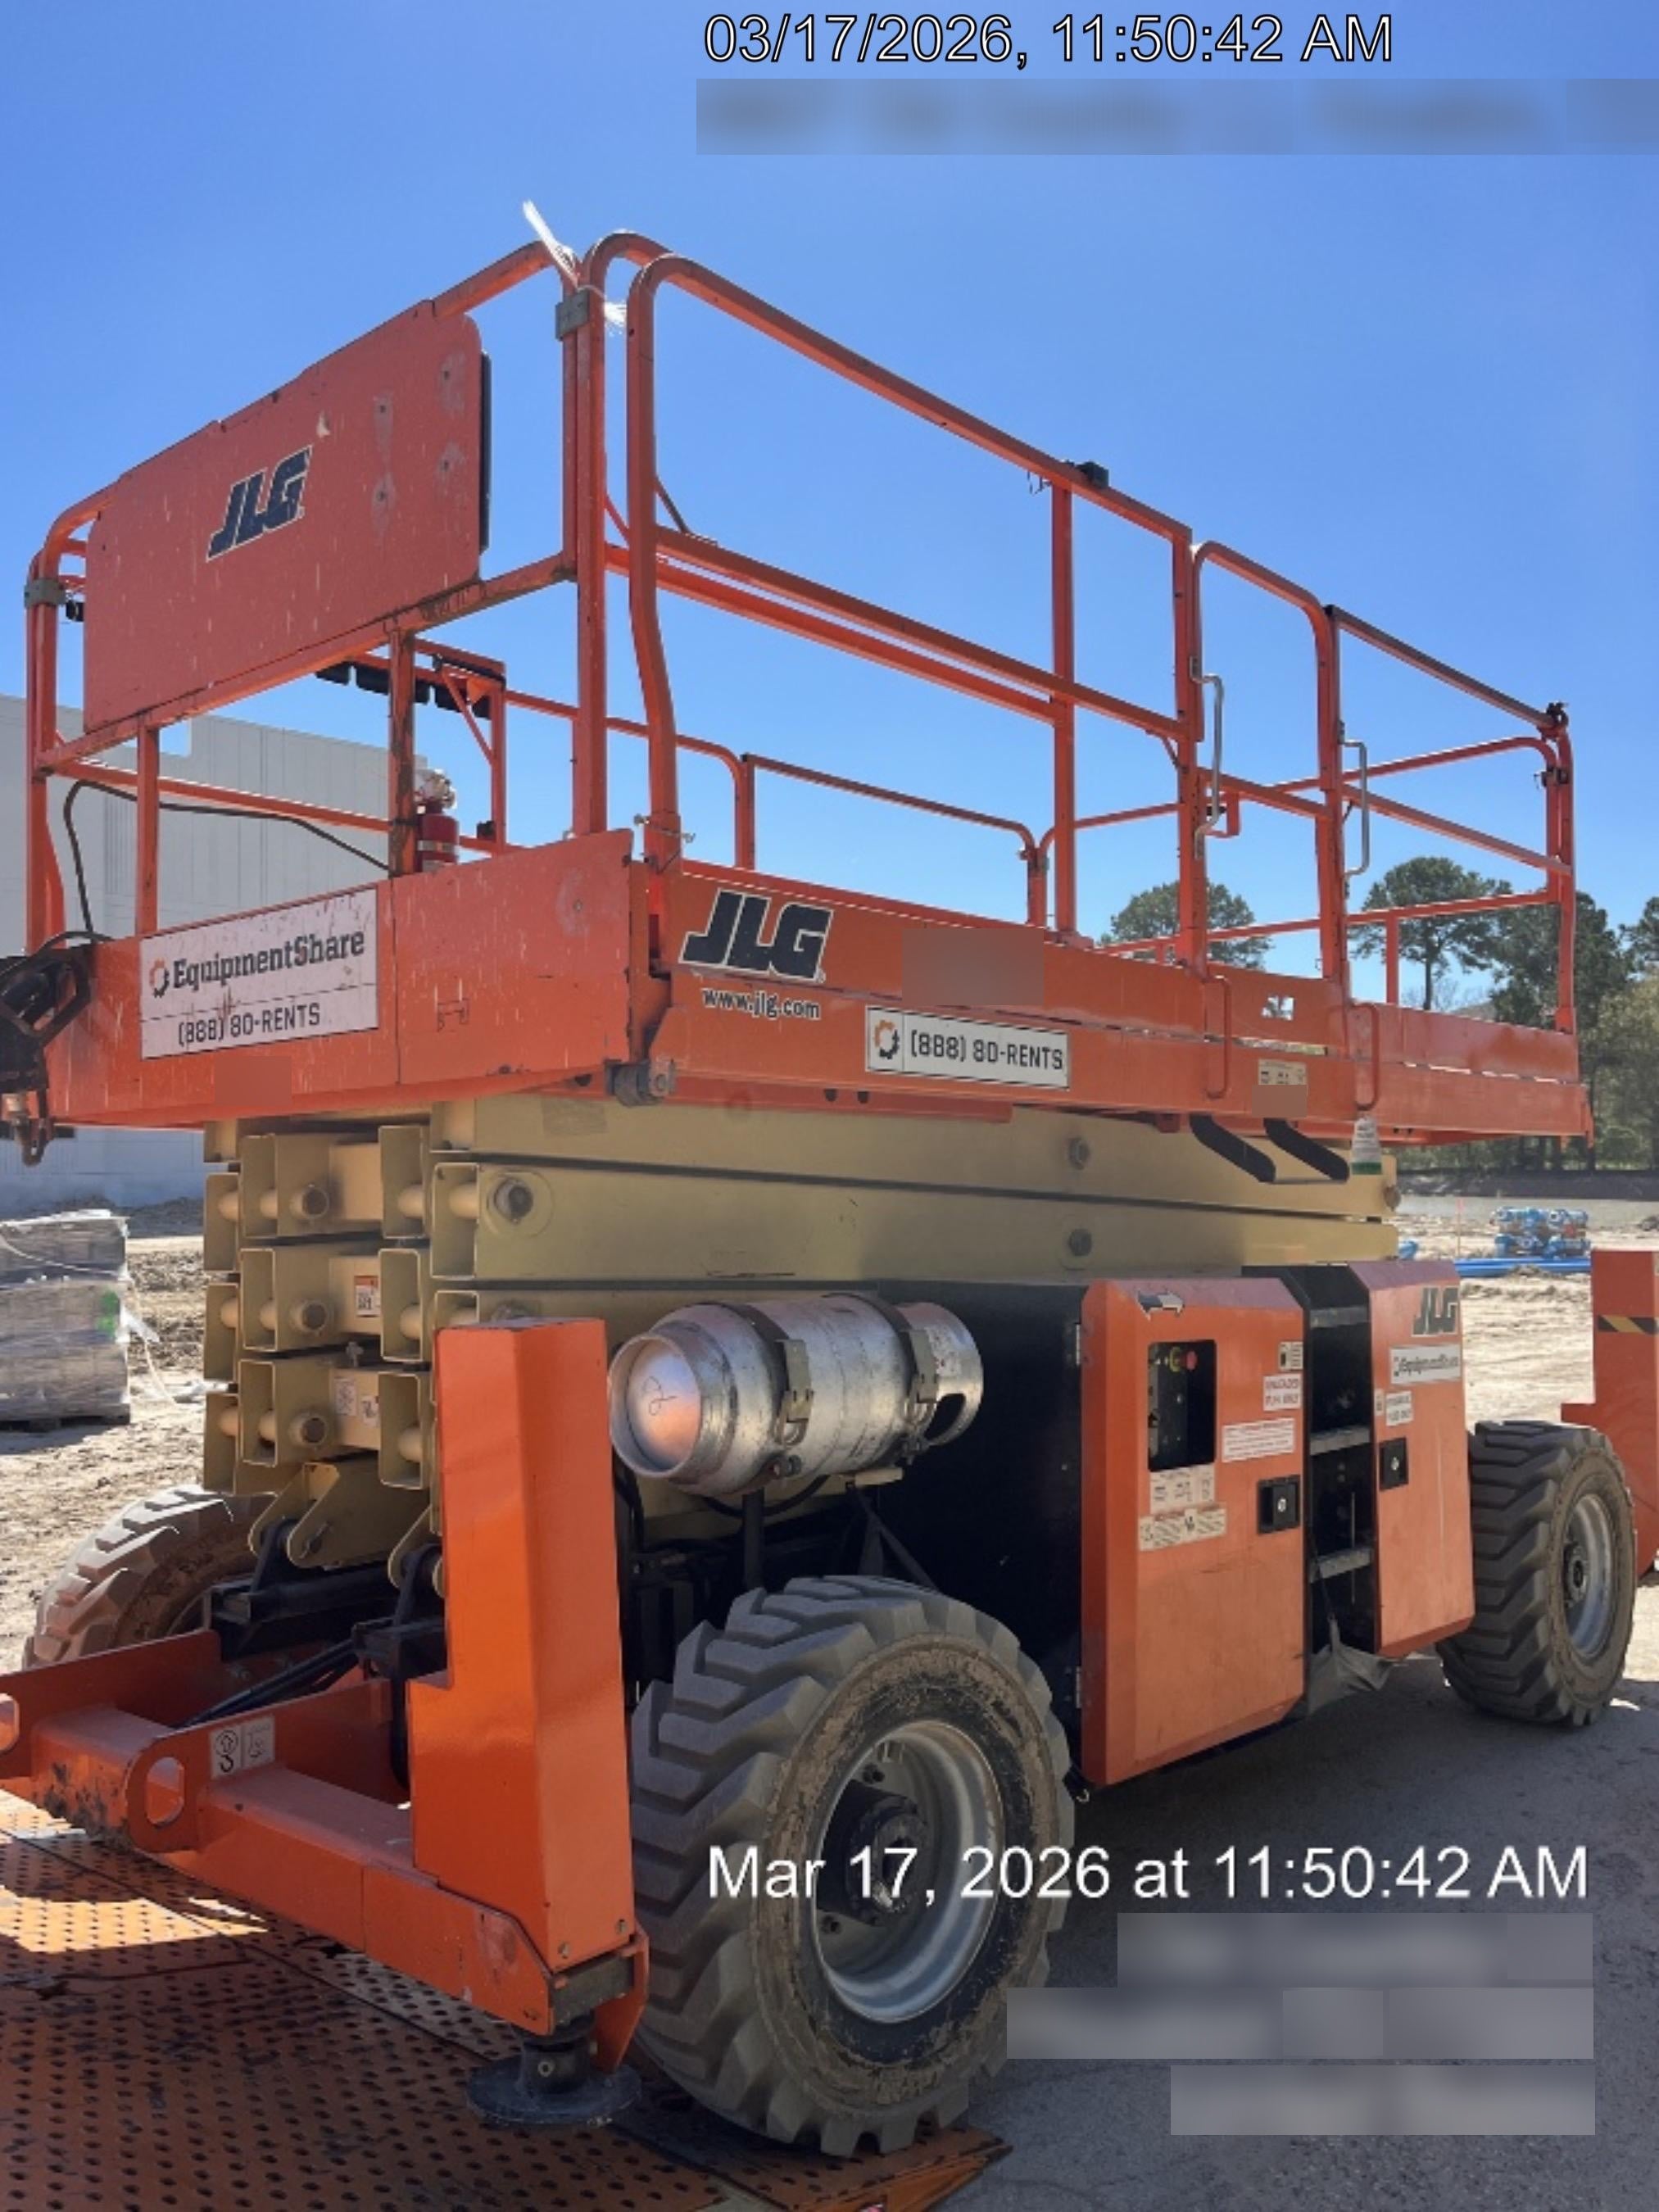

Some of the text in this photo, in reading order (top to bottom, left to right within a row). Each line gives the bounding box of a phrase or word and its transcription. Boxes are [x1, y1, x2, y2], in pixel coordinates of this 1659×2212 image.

[206, 445, 312, 562] JLG
[678, 888, 834, 981] JLG
[173, 931, 365, 991] EquipmentShare
[178, 1003, 320, 1046] (888) 80-RENTS
[701, 988, 821, 1020] www.jlg.com
[910, 1029, 1063, 1070] (888) 80-RENTS
[1411, 1285, 1459, 1337] JLG
